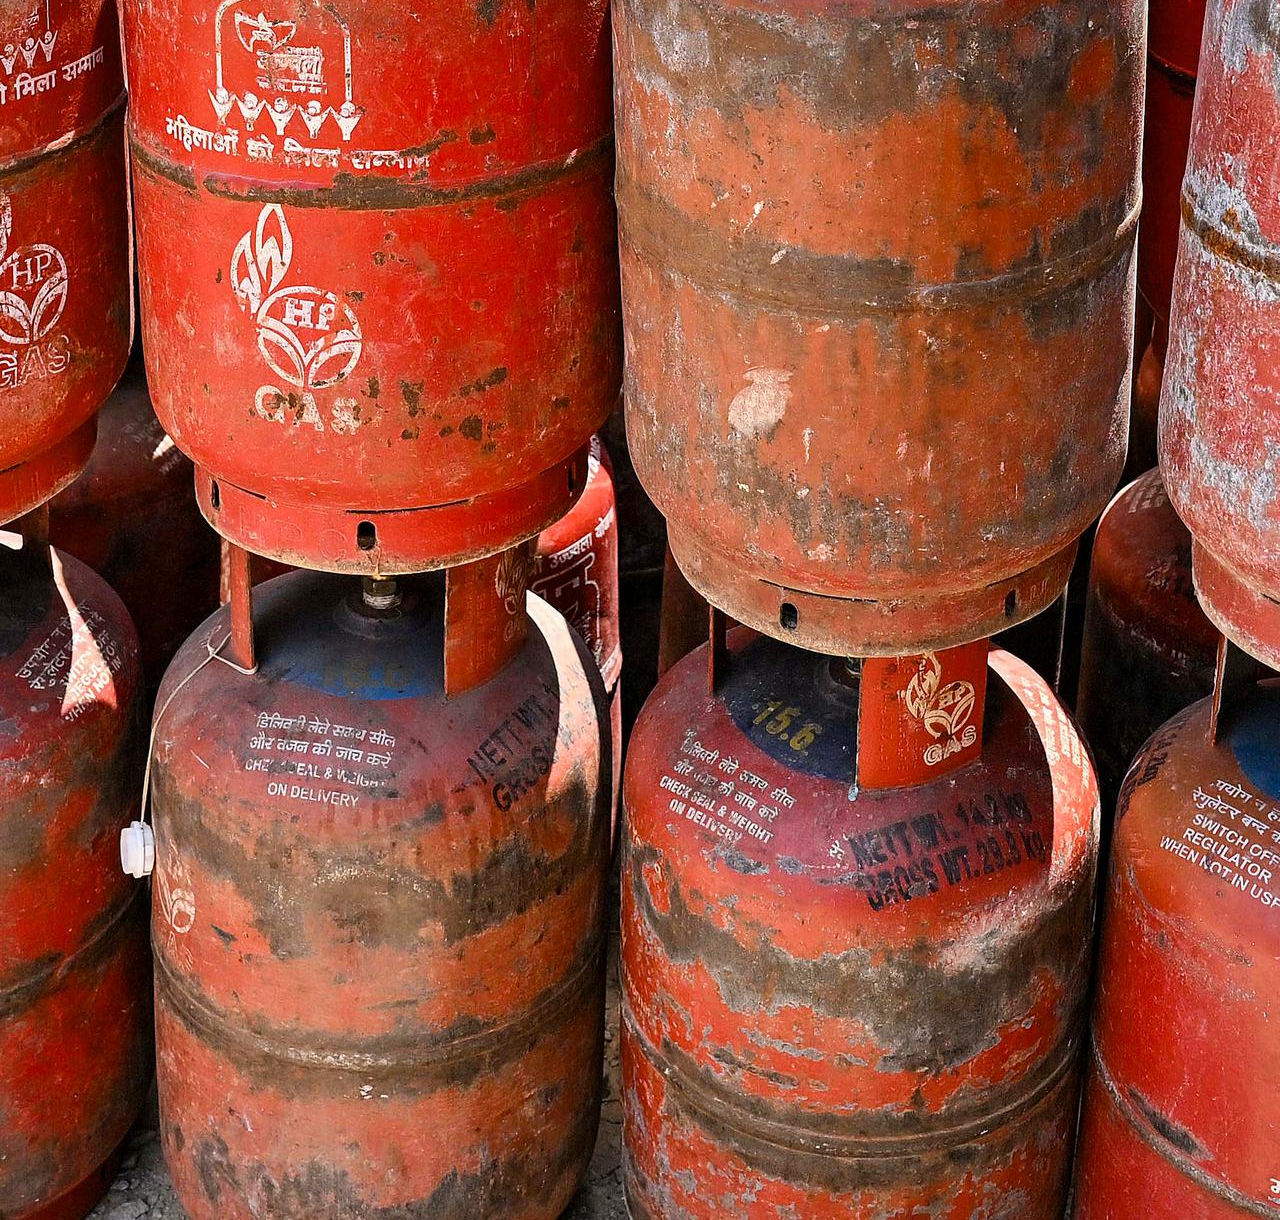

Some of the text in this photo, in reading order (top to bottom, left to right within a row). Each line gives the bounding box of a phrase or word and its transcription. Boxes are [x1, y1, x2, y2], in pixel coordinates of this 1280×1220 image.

[15, 71, 57, 100] मिला
[62, 45, 104, 82] सम्मान
[166, 115, 239, 155] महिलाओं
[9, 252, 52, 289] HP
[282, 298, 336, 330] HP
[255, 385, 359, 434] GAS
[308, 716, 330, 735] लेते
[752, 701, 823, 752] 15.6
[923, 725, 977, 766] GAS
[250, 731, 394, 769] और वजन की जांच करें
[467, 720, 519, 785] NETT
[324, 767, 333, 779] &
[267, 782, 359, 807] ON DELIVERY
[659, 775, 774, 844] CHECK SEAL & WEIGHT
[1192, 786, 1242, 820] रेगुलेटर
[669, 798, 744, 843] ON DELIVERY
[1192, 814, 1249, 850] SWITCH
[849, 821, 913, 870] NETT
[938, 844, 981, 887] WT.
[1159, 835, 1199, 864] WHEN
[1199, 855, 1232, 879] NOT
[1231, 873, 1249, 892] IN
[1183, 828, 1273, 884] REGULATOR
